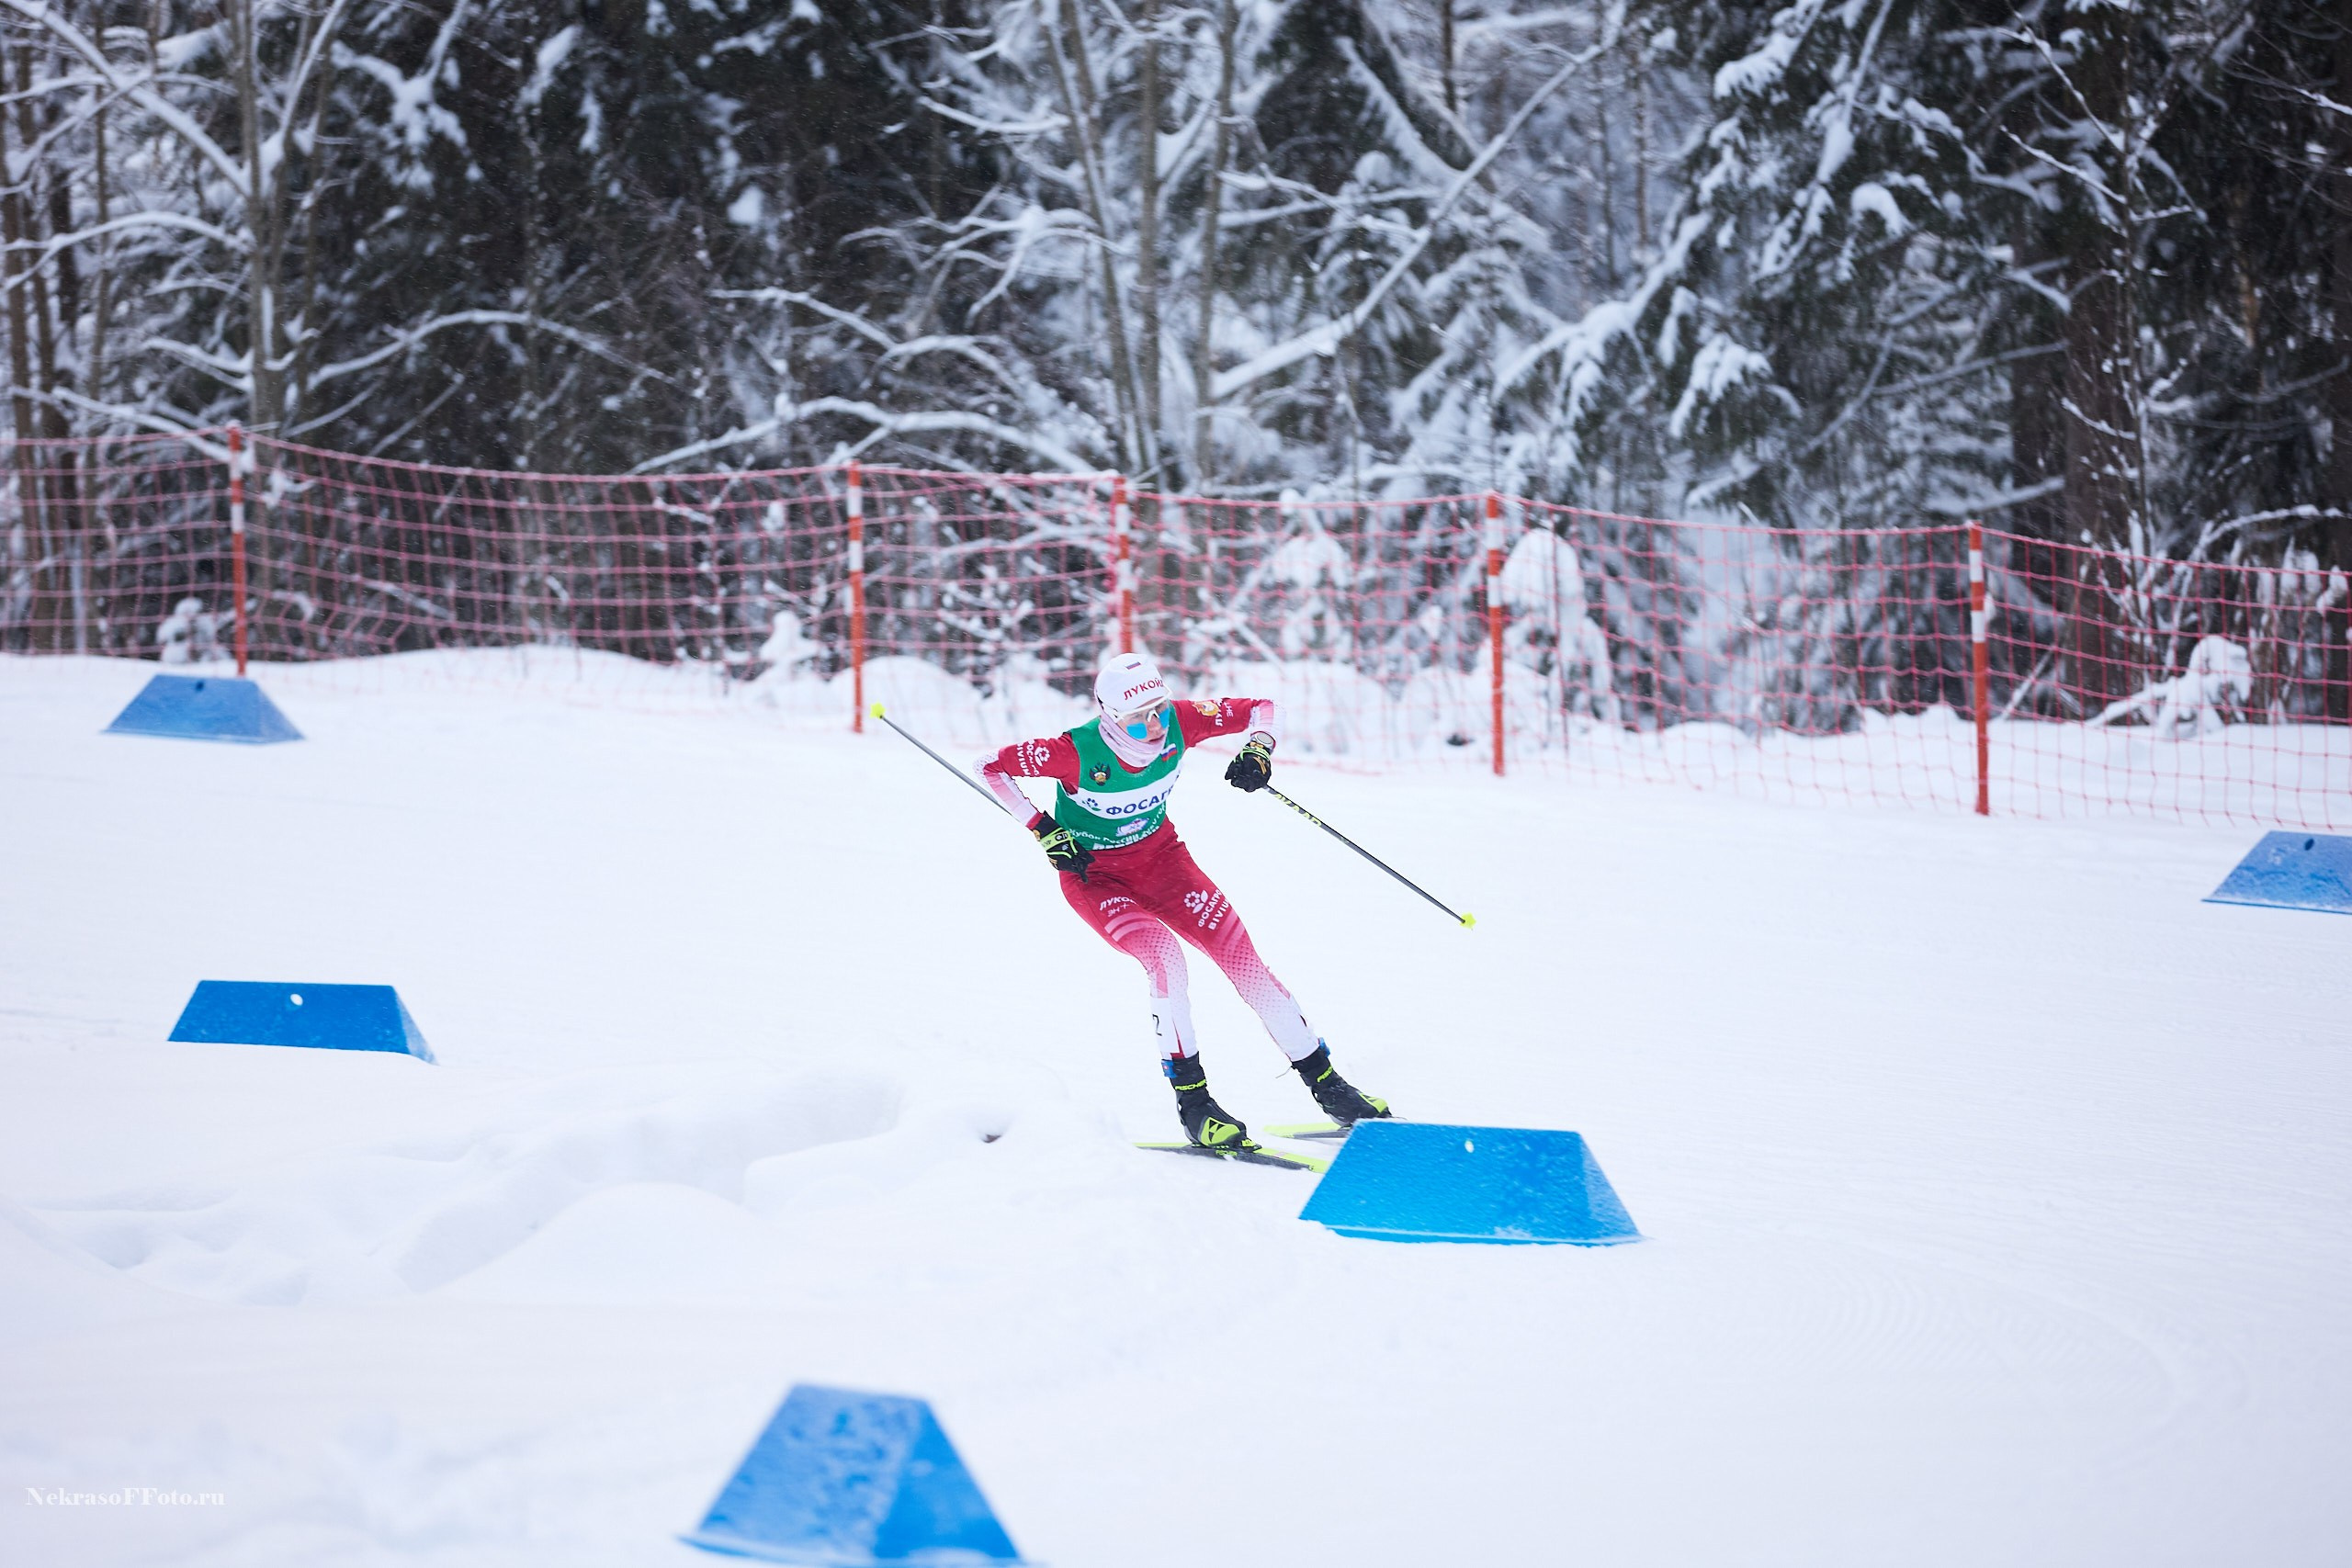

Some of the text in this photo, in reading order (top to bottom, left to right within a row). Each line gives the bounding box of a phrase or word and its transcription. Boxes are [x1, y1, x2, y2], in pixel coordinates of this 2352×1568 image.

[1106, 774, 1178, 815] ФОСАГ
[1099, 896, 1139, 911] ЛУКО
[1208, 899, 1229, 931] BIVIU
